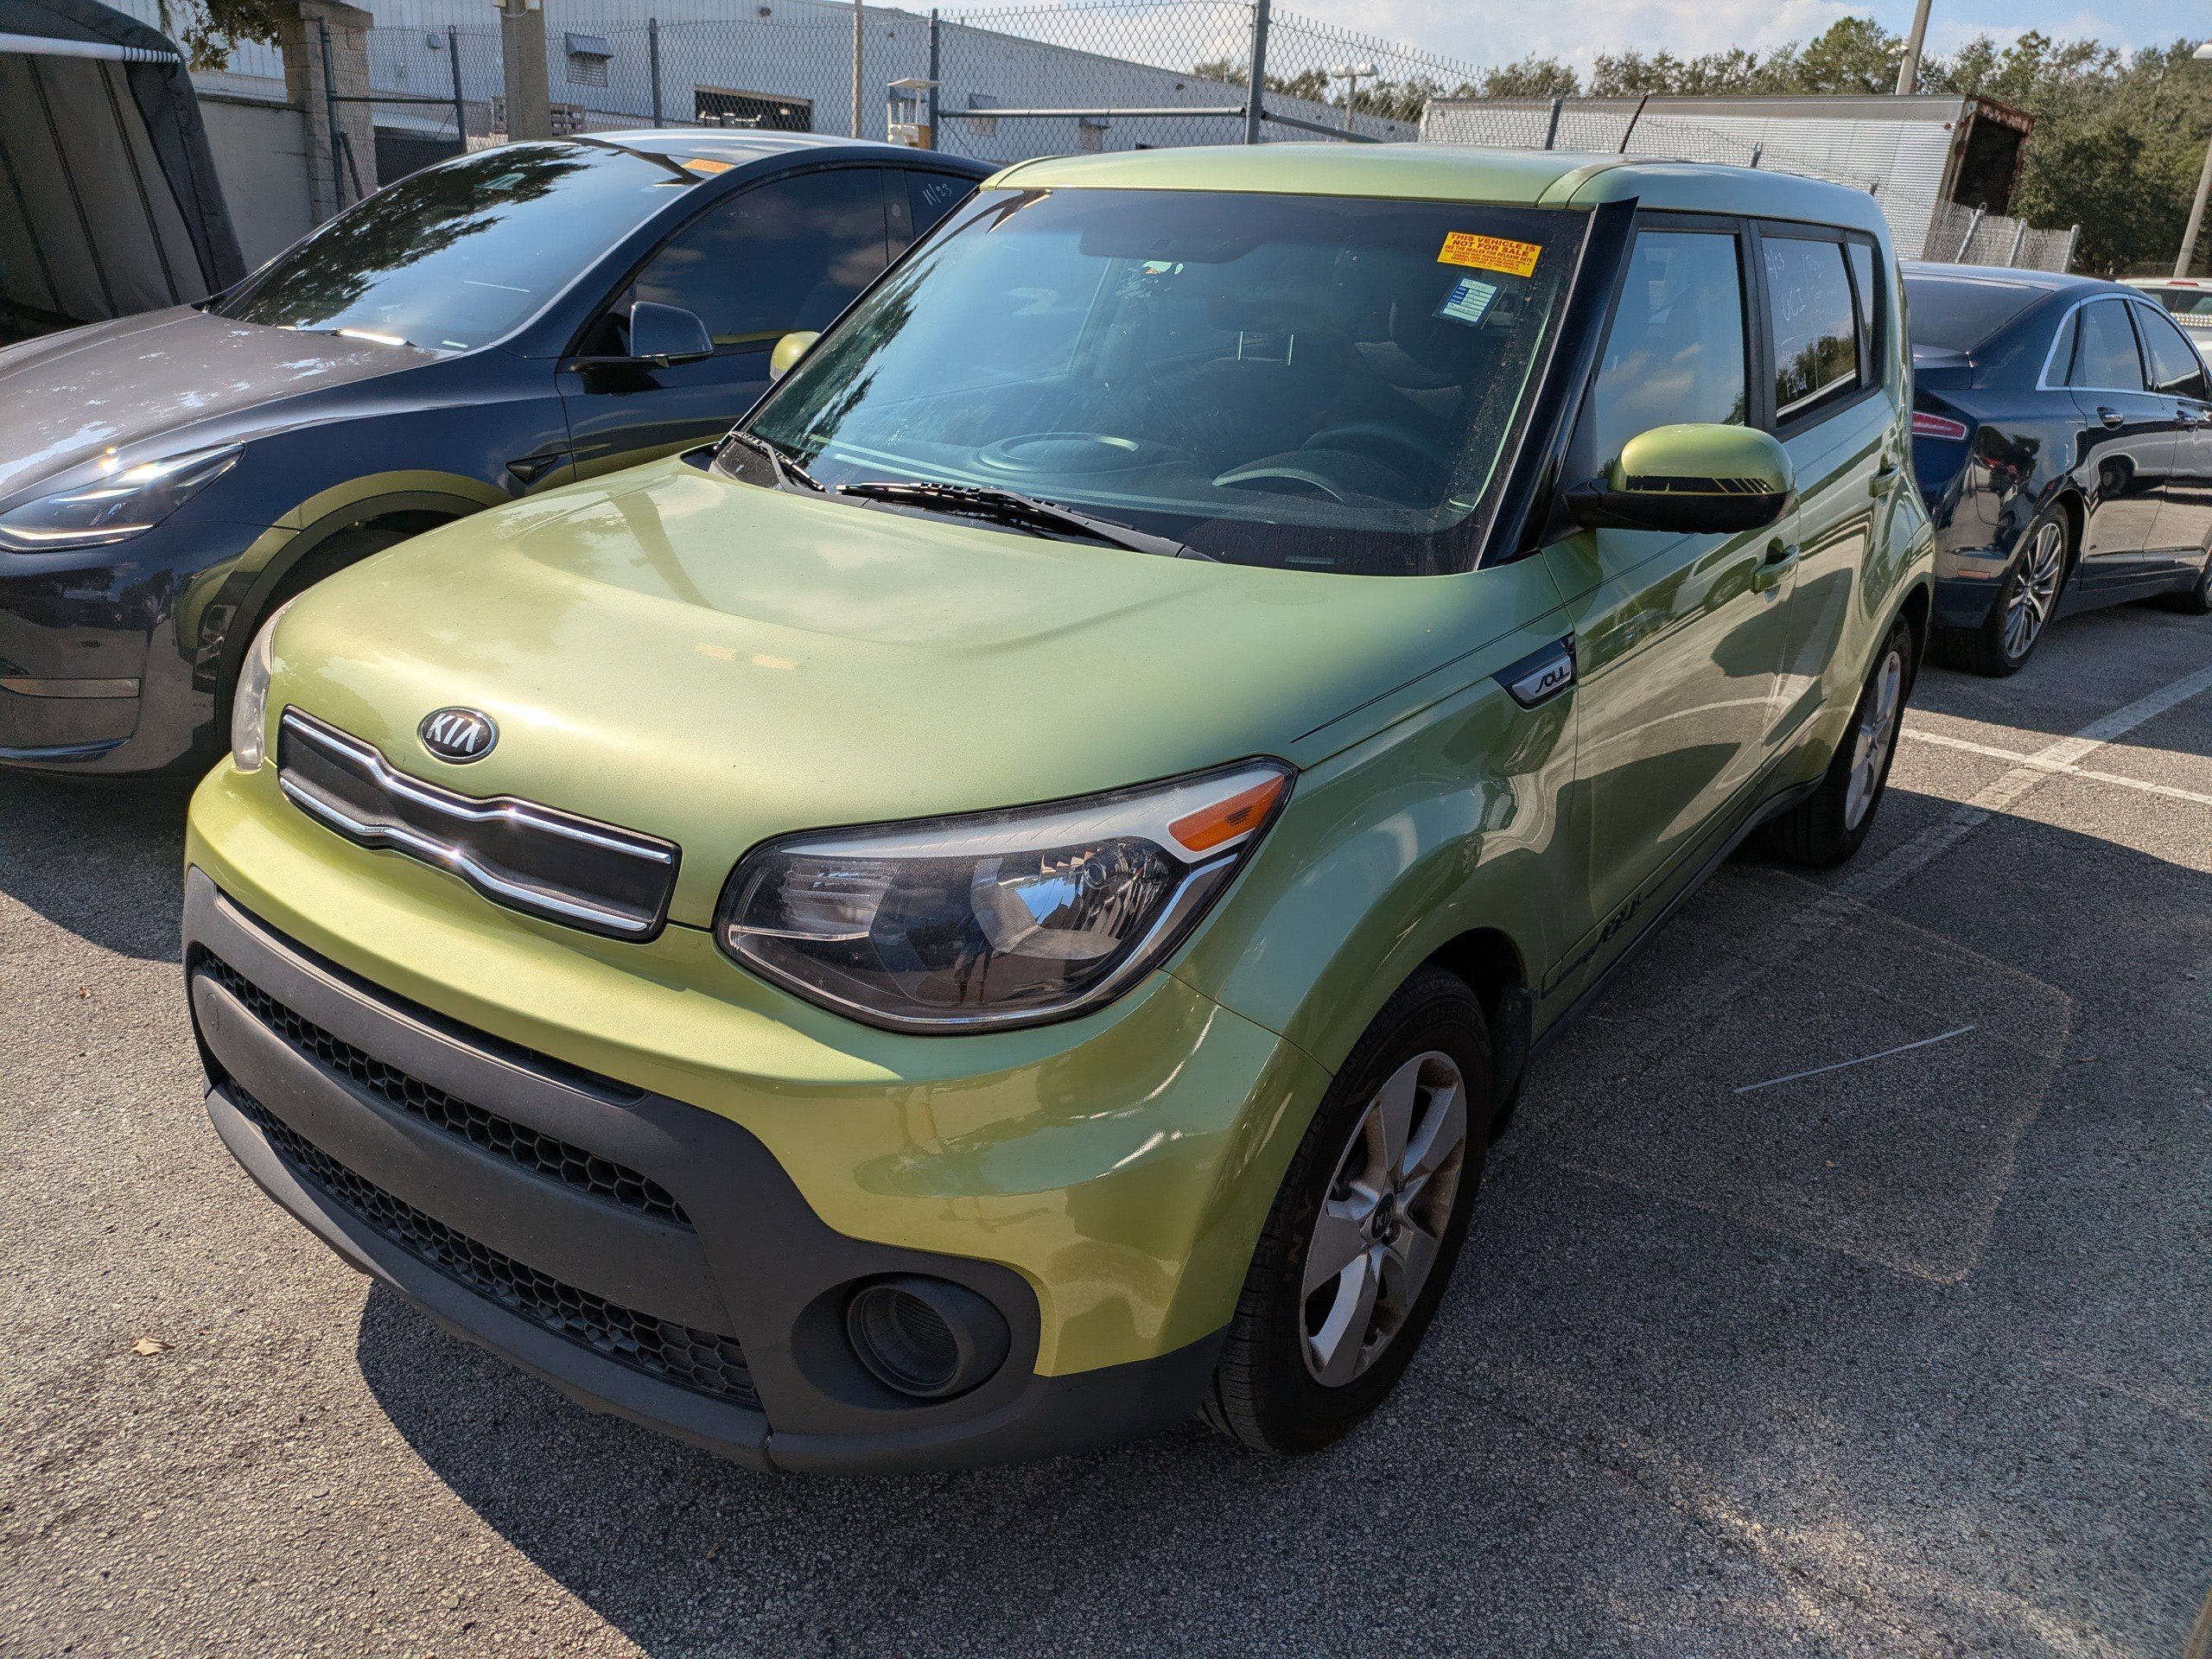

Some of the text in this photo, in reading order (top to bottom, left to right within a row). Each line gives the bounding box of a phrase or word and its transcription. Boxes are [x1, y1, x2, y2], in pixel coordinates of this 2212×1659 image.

[1451, 233, 1474, 242] THIS
[1478, 237, 1523, 250] VEHICLE
[1452, 239, 1530, 257] NOT FOR SALE
[425, 713, 481, 753] KIA
